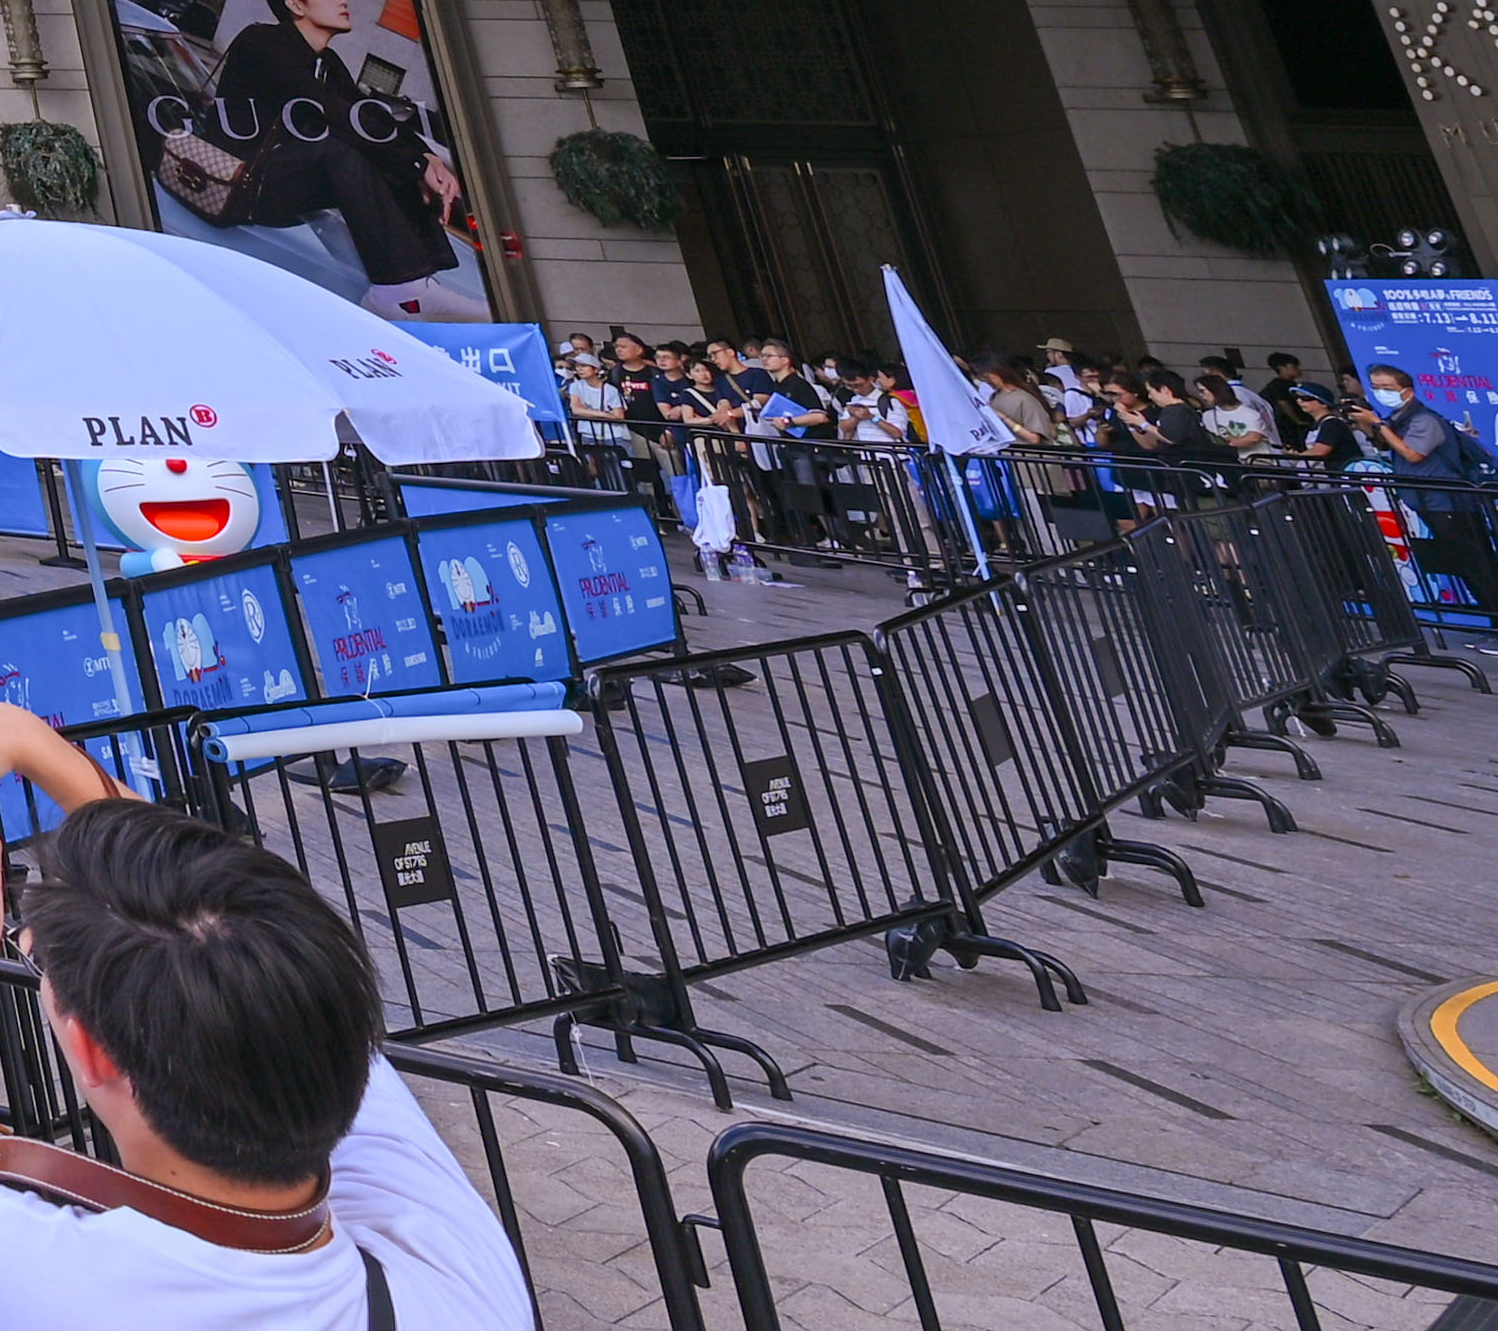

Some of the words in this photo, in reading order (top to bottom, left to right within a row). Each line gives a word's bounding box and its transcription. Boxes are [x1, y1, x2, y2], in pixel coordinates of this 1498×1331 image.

[146, 94, 437, 144] GUCCI
[330, 358, 403, 379] PLAN
[82, 415, 192, 446] PLAN
[578, 572, 631, 599] PRUDENTIAL
[452, 609, 506, 640] DORAEMON
[332, 627, 388, 662] PRUDENTIAL
